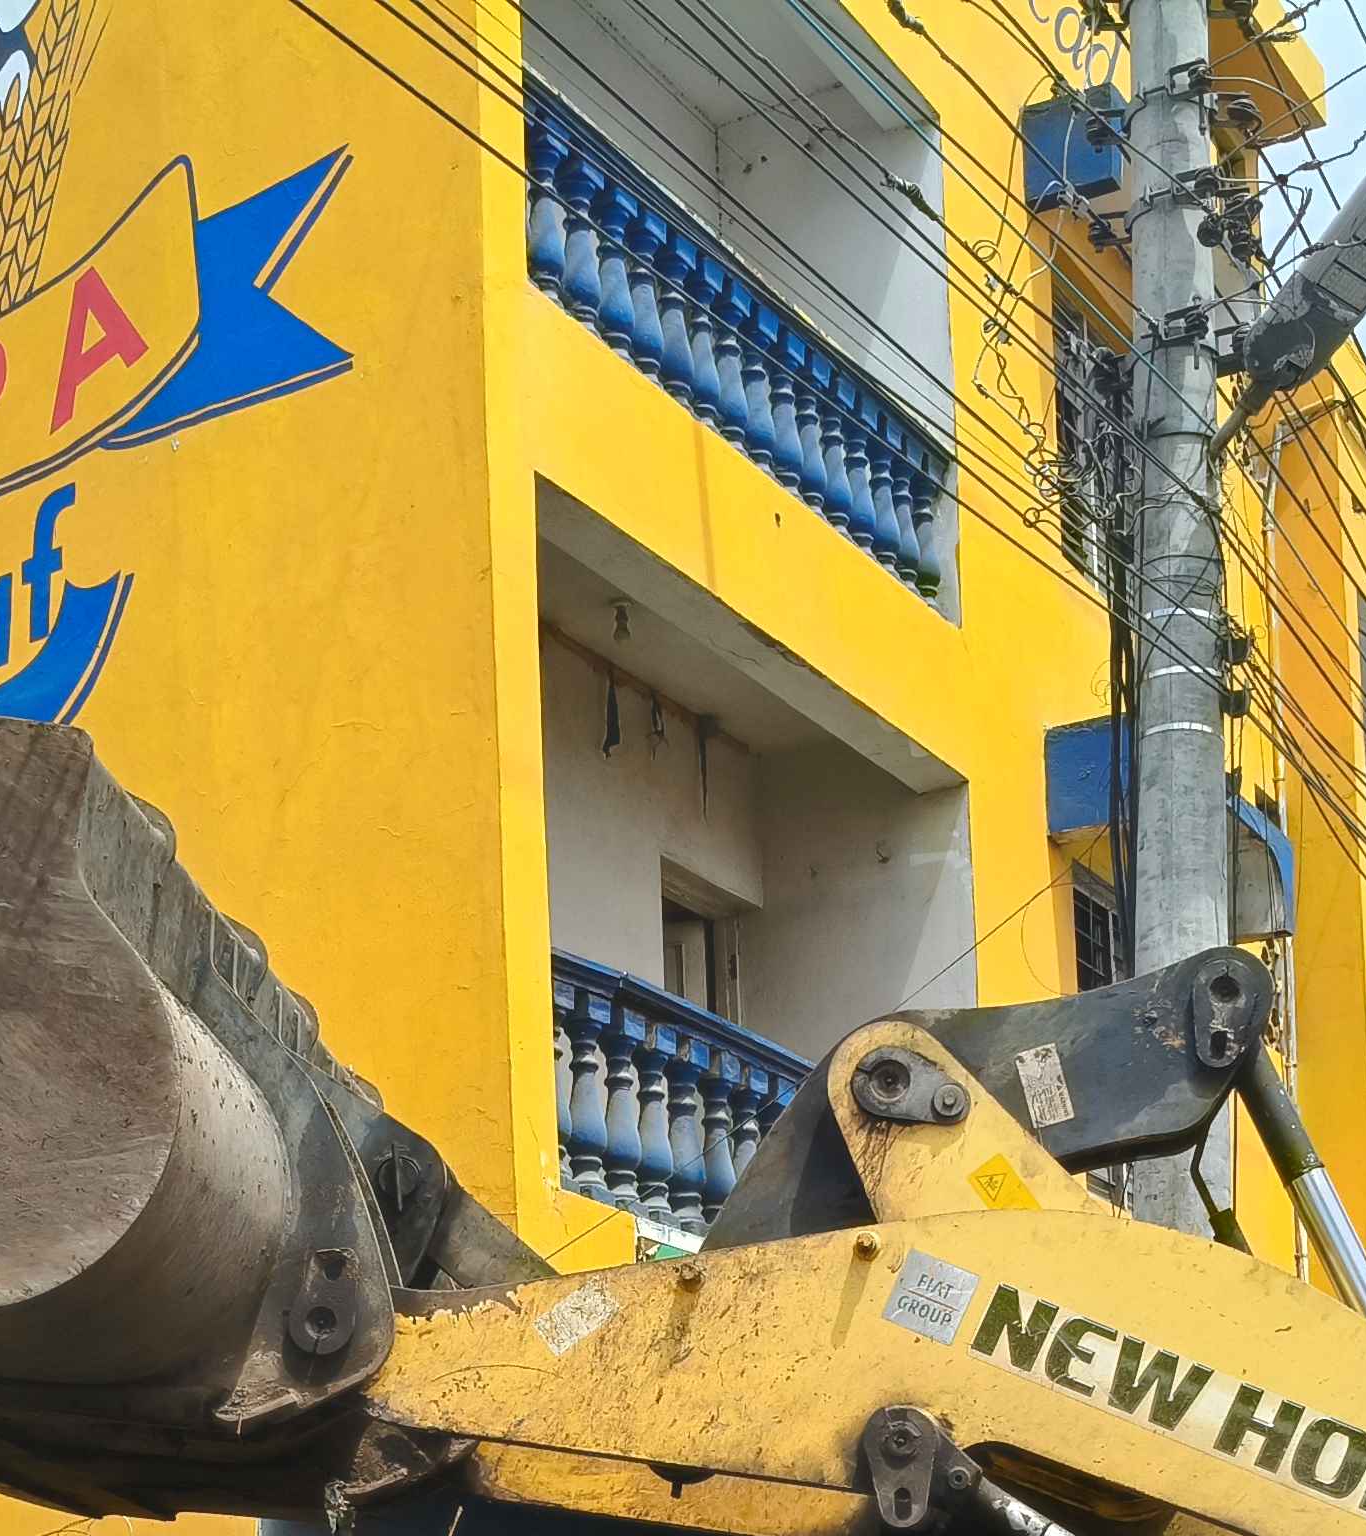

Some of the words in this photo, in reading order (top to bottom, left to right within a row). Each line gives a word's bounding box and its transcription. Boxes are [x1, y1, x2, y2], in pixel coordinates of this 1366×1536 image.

[917, 1273, 955, 1300] FIAT
[897, 1294, 953, 1326] GROUP
[970, 1283, 1213, 1431] NEW
